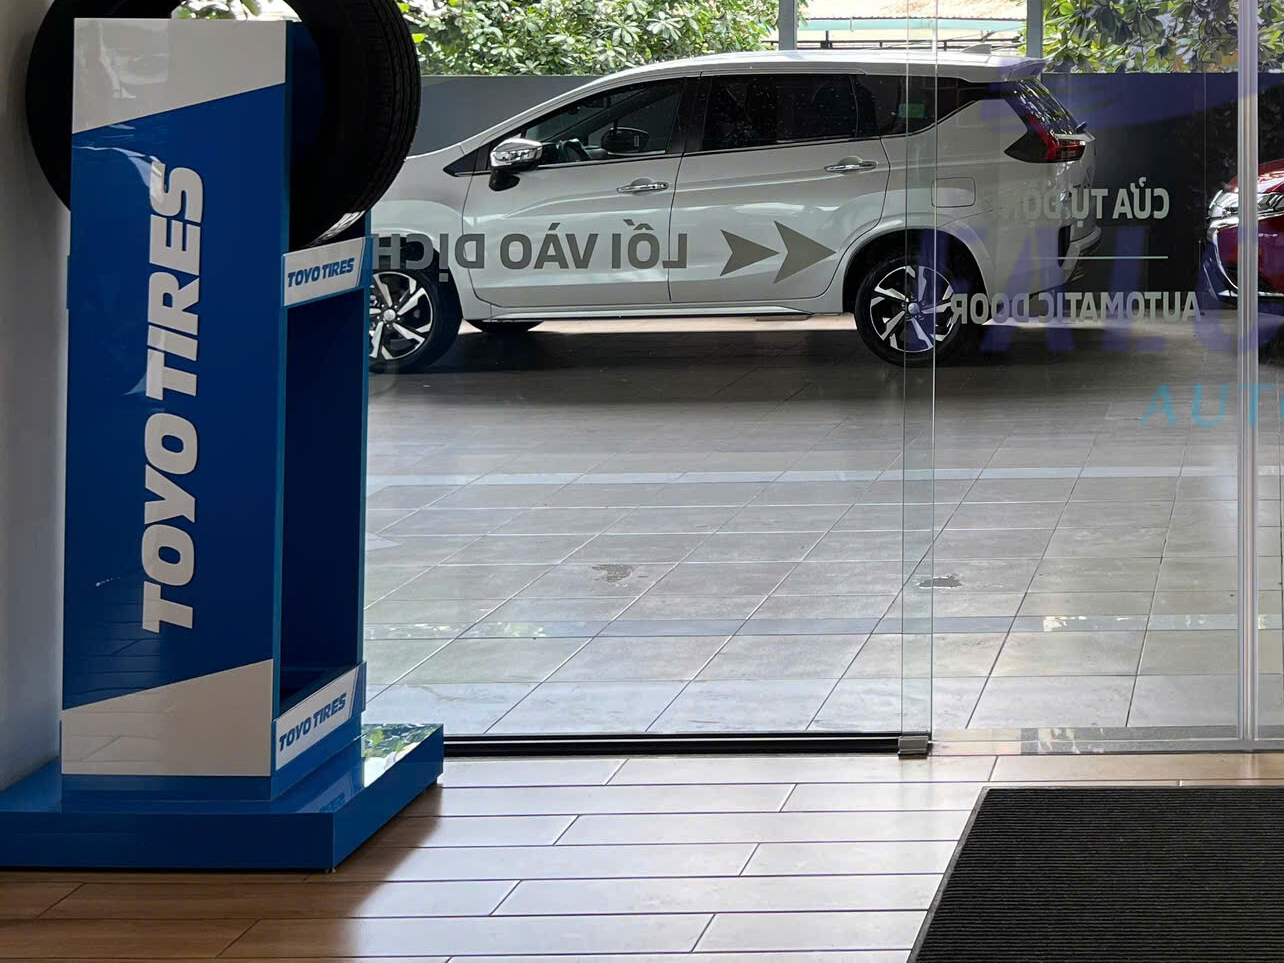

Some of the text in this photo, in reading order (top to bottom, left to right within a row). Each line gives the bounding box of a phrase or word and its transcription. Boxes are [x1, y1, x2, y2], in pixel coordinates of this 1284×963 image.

[287, 257, 355, 287] TOYO TIRES
[141, 163, 205, 634] TOYO TIRES
[279, 692, 347, 752] TOYO TIRES
